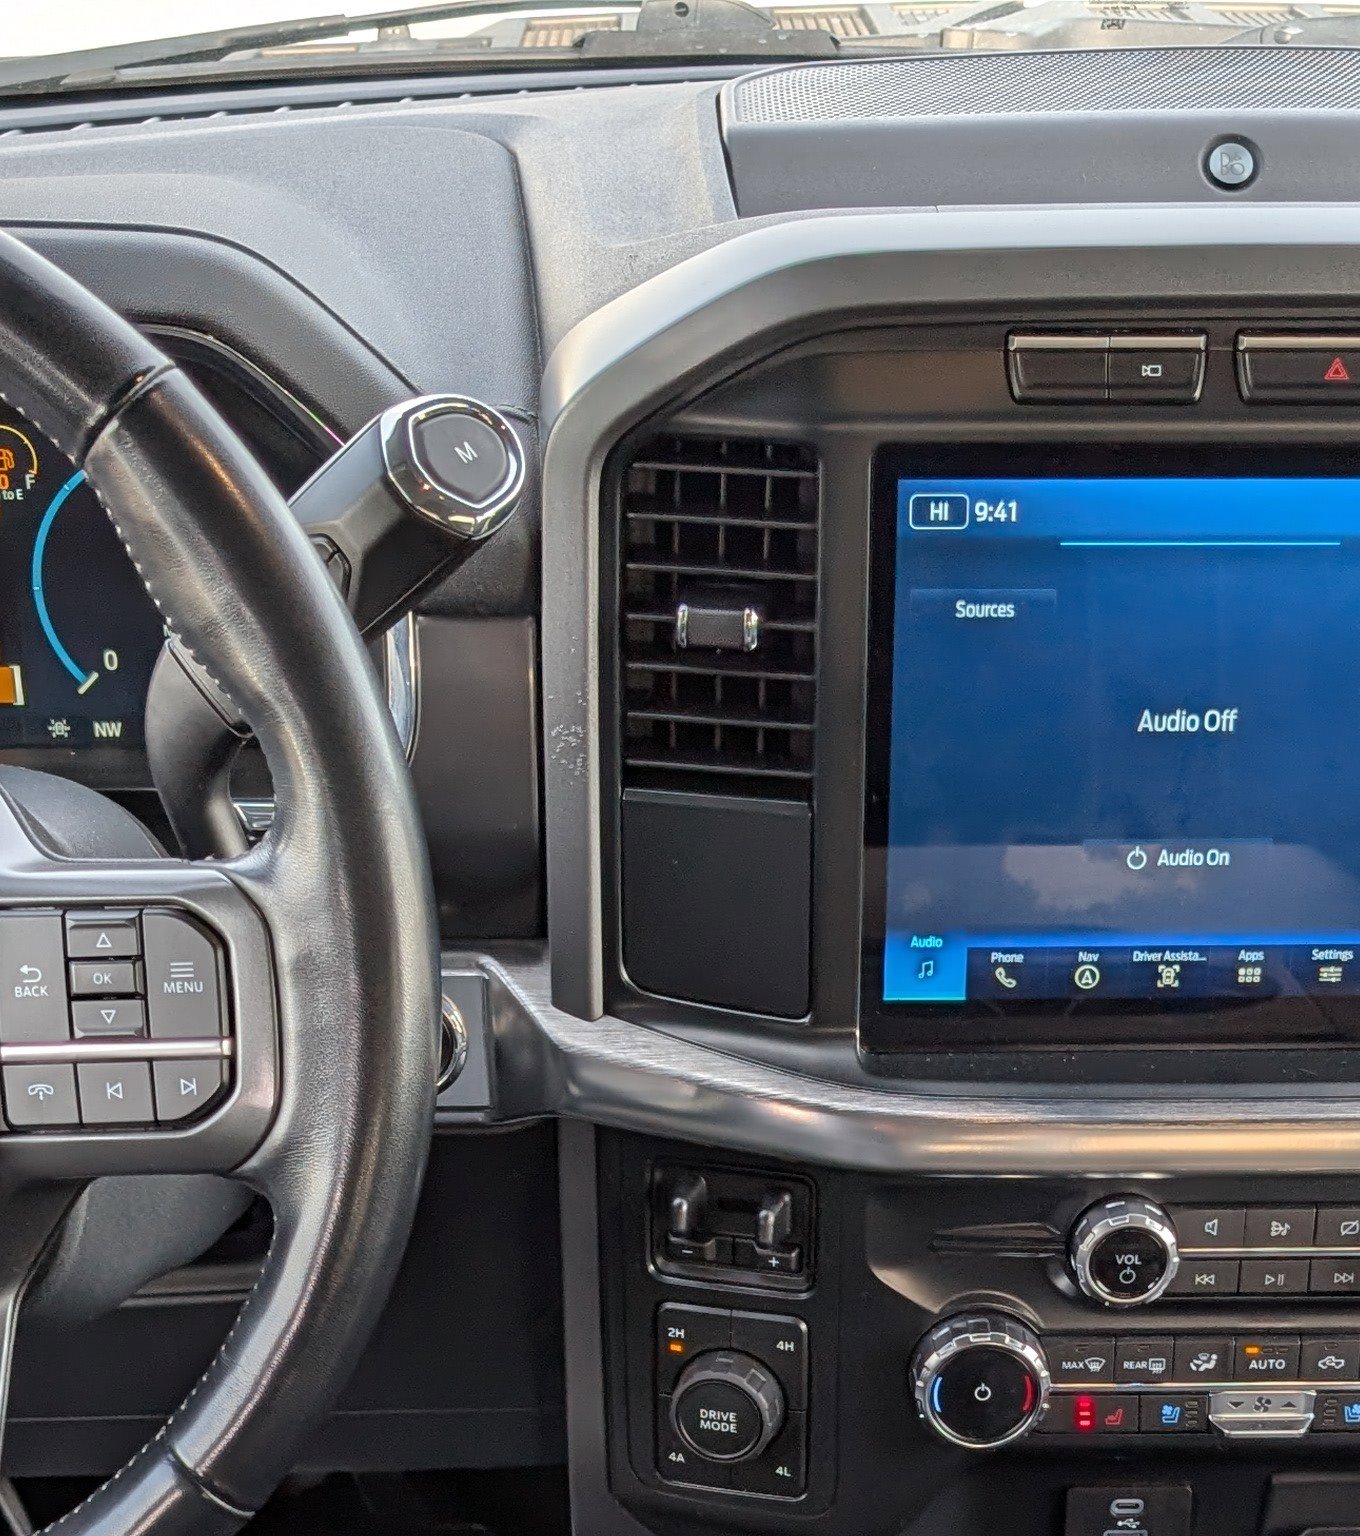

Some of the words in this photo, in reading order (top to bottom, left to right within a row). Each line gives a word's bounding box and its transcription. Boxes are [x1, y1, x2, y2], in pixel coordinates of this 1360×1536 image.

[453, 441, 478, 464] M
[25, 474, 36, 490] F
[1, 490, 15, 500] to
[16, 489, 24, 500] E
[929, 501, 950, 522] HI
[974, 500, 1019, 523] 9:41
[954, 600, 1016, 619] Sources
[102, 649, 119, 671] 0
[1136, 708, 1200, 733] Audio
[1203, 707, 1239, 733] Off
[93, 720, 123, 738] NW
[1156, 848, 1203, 867] Audio
[1206, 849, 1230, 867] On
[910, 935, 943, 949] Audio
[990, 951, 1024, 964] Phone
[1078, 951, 1099, 963] Nav
[1132, 950, 1162, 962] Driver
[1238, 949, 1265, 962] Apps
[1311, 948, 1354, 962] Settings
[93, 972, 112, 985] OK
[14, 986, 49, 998] BACK
[163, 981, 204, 994] MENU
[1115, 1254, 1142, 1266] VOL
[667, 1327, 685, 1339] 2H
[776, 1340, 795, 1352] 4H
[1062, 1360, 1085, 1370] MAX
[1123, 1360, 1148, 1370] REAR
[1249, 1359, 1286, 1371] AUTO
[699, 1408, 737, 1422] DRIVE
[700, 1420, 738, 1433] MODE
[668, 1451, 686, 1464] 4A
[775, 1465, 792, 1477] 4L
